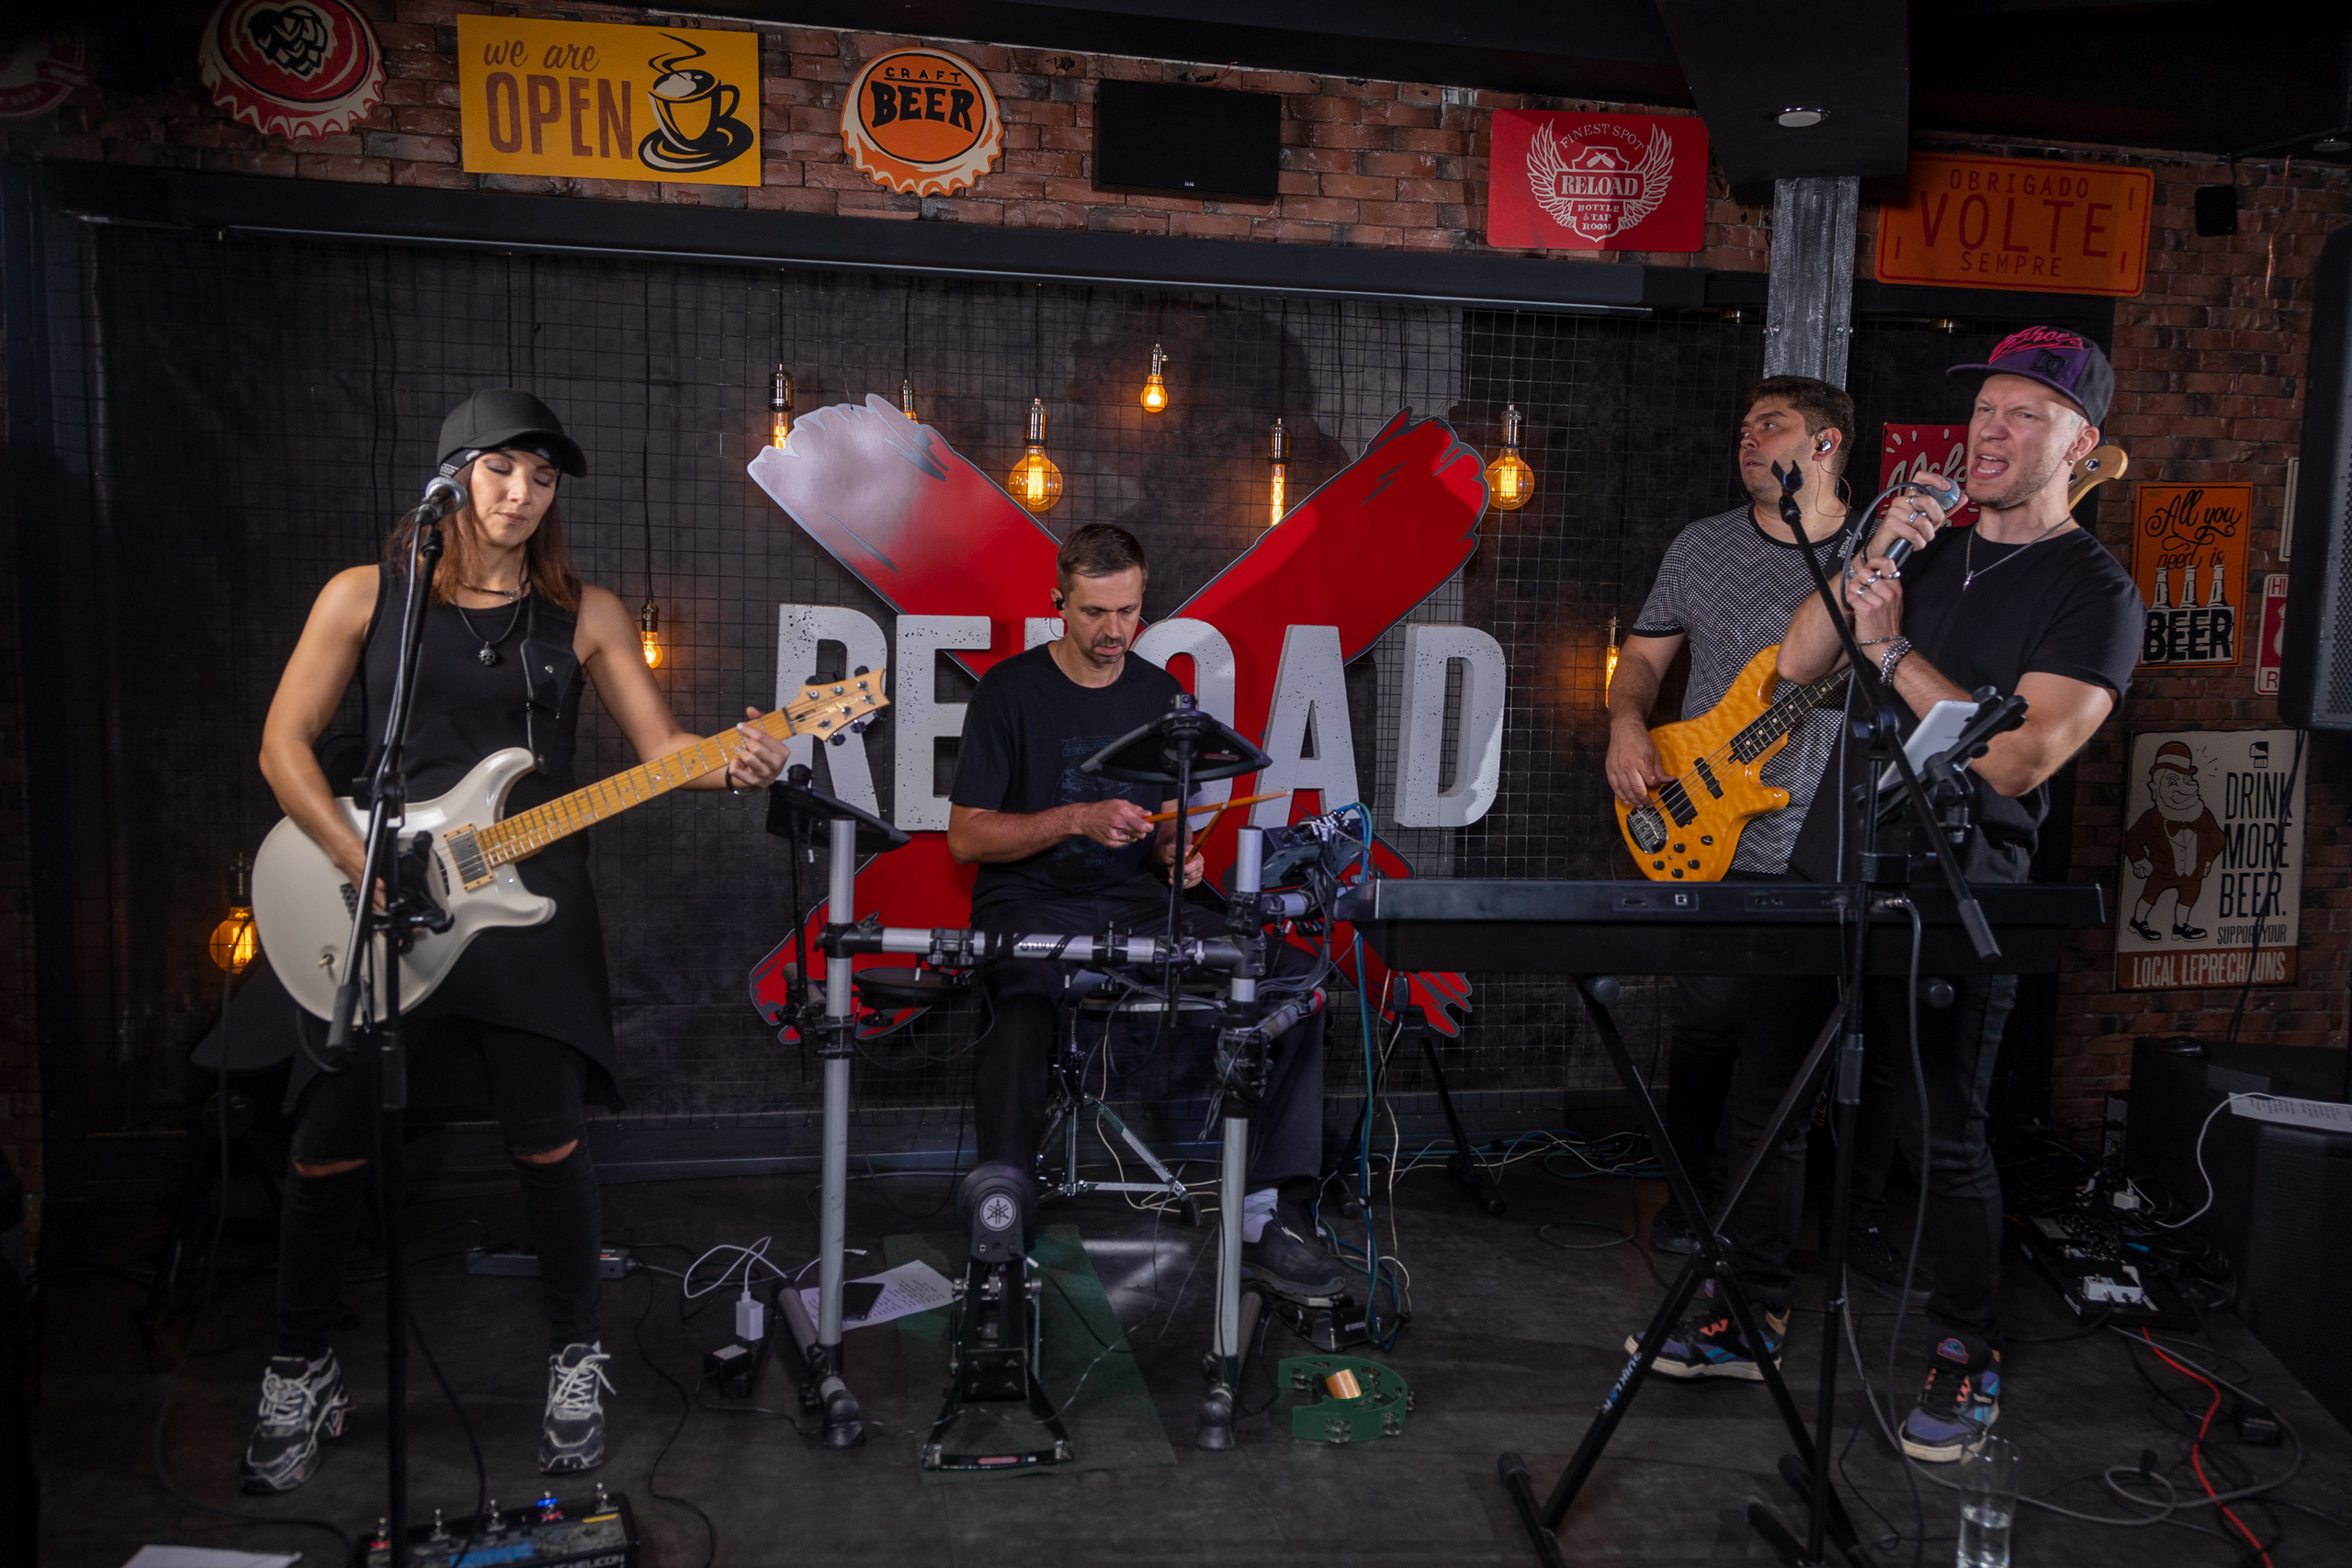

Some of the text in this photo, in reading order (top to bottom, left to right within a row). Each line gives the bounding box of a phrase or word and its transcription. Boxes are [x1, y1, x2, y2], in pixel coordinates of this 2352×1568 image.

[483, 40, 600, 71] we are
[885, 67, 962, 82] CRAFT
[486, 72, 633, 160] OPEN
[871, 81, 975, 133] BEER
[1559, 123, 1645, 151] FINEST SPOT
[1561, 175, 1638, 196] RELOAD
[1950, 169, 2088, 198] OBRIGADO
[1577, 204, 1620, 213] BOTTLE
[1590, 213, 1611, 221] TAP
[1582, 222, 1611, 231] ROOM
[1920, 191, 2112, 258] VOLTE
[1961, 251, 2063, 277] SEMPRE
[2145, 490, 2242, 540] All you
[2157, 547, 2225, 570] need is
[2143, 608, 2233, 660] BEER
[2225, 773, 2292, 819] DRINK
[2222, 823, 2291, 869] MORE
[2219, 872, 2287, 919] BEER.
[2263, 924, 2287, 943] YOUR
[2133, 951, 2286, 988] LOCAL LEPRECHAUNS
